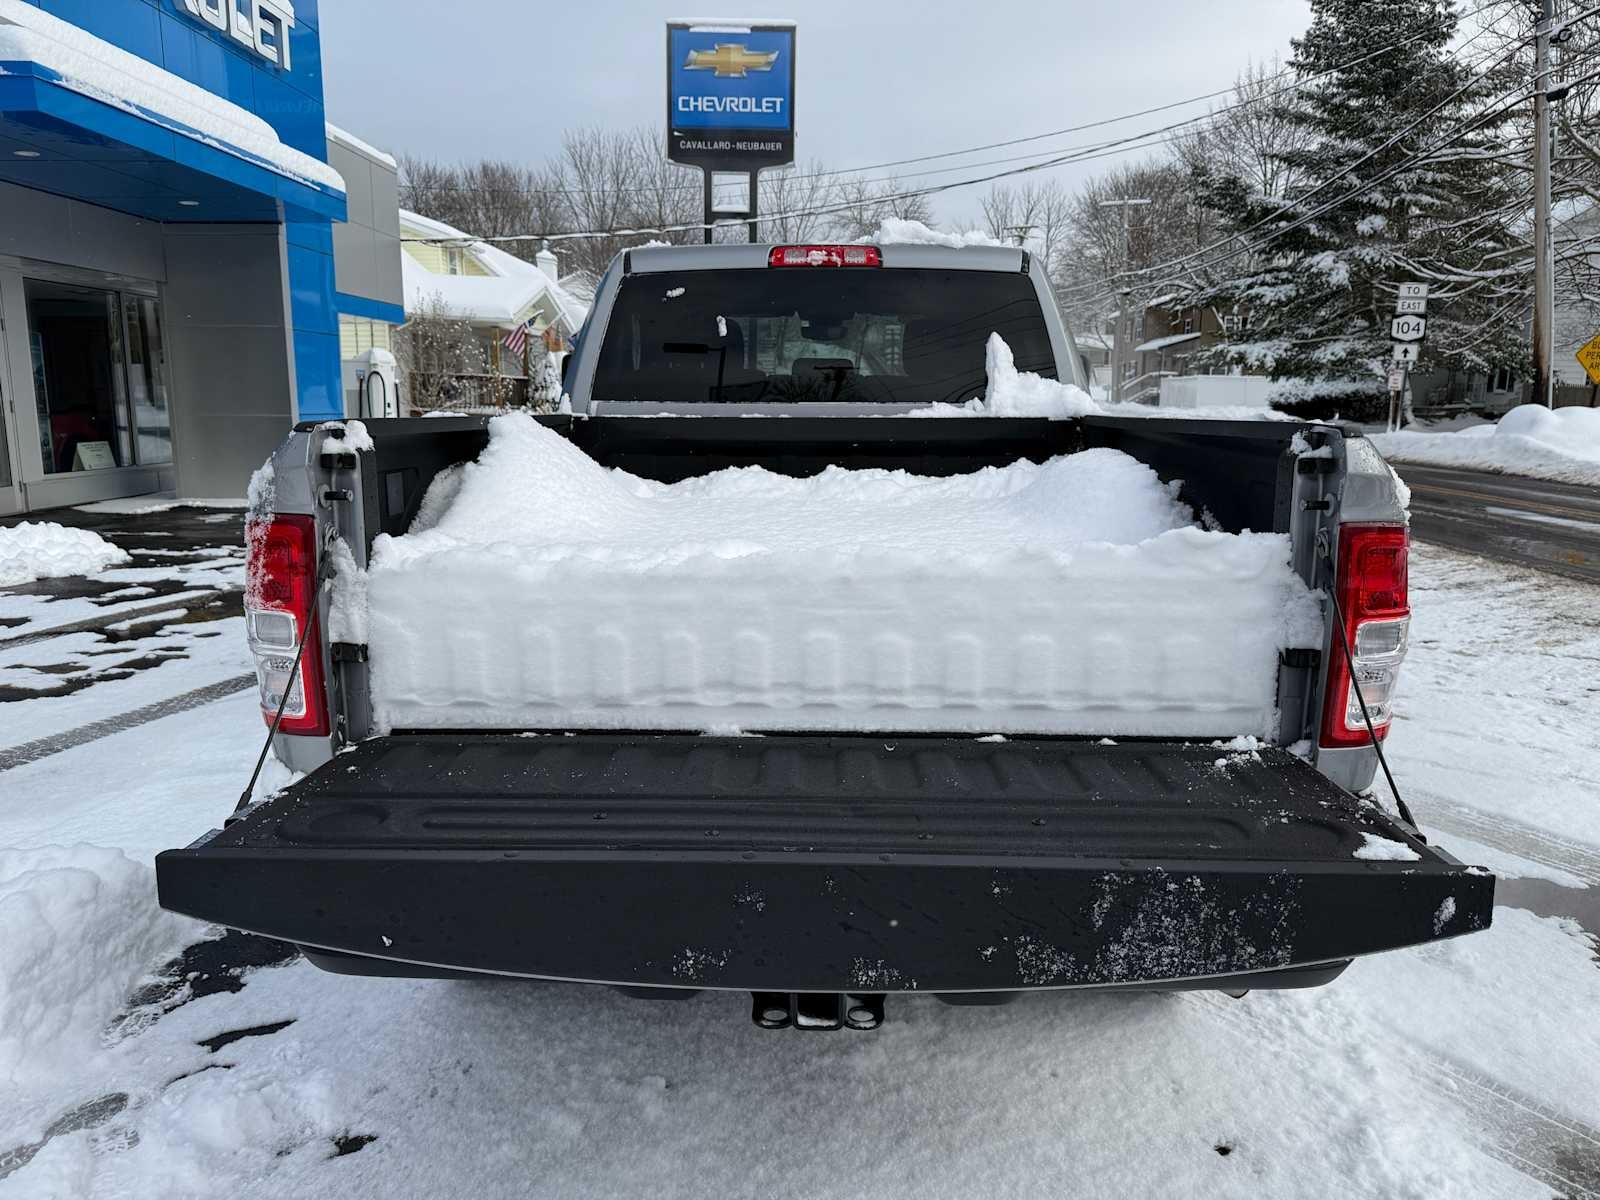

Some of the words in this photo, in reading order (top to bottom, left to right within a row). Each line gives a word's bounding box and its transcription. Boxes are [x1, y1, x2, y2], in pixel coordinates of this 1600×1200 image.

[678, 96, 784, 113] CHEVROLET
[679, 140, 782, 151] CAVALLARO-NEUBAUER
[1406, 286, 1420, 294] TO
[1401, 301, 1421, 311] EAST
[1396, 321, 1421, 335] 104
